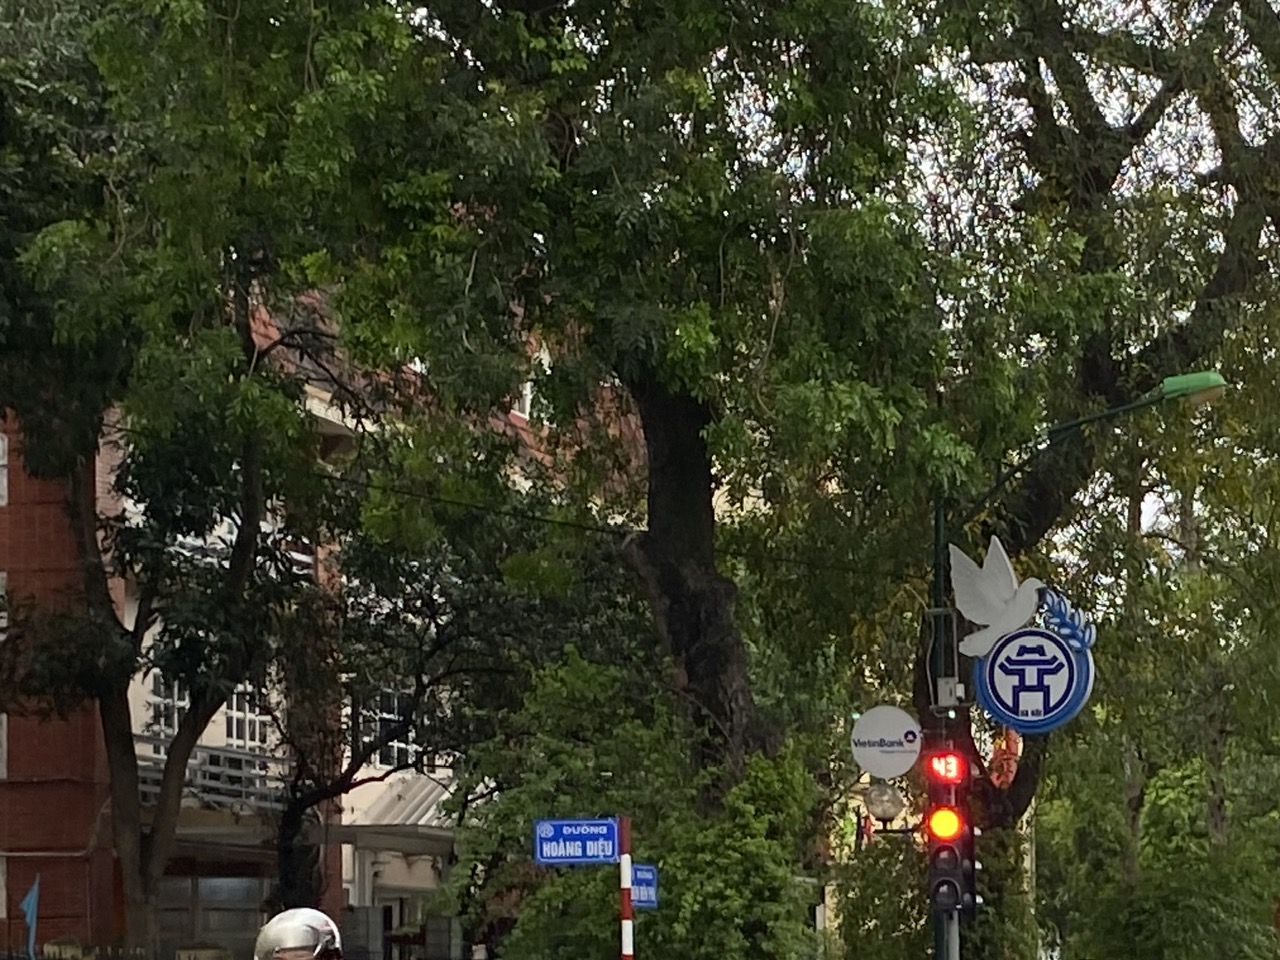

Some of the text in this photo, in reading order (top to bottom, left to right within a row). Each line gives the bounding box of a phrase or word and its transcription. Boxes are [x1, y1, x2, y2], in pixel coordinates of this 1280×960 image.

[852, 737, 905, 748] VietinBank
[931, 754, 957, 778] 43
[542, 838, 613, 860] HOÀNG DIỆU
